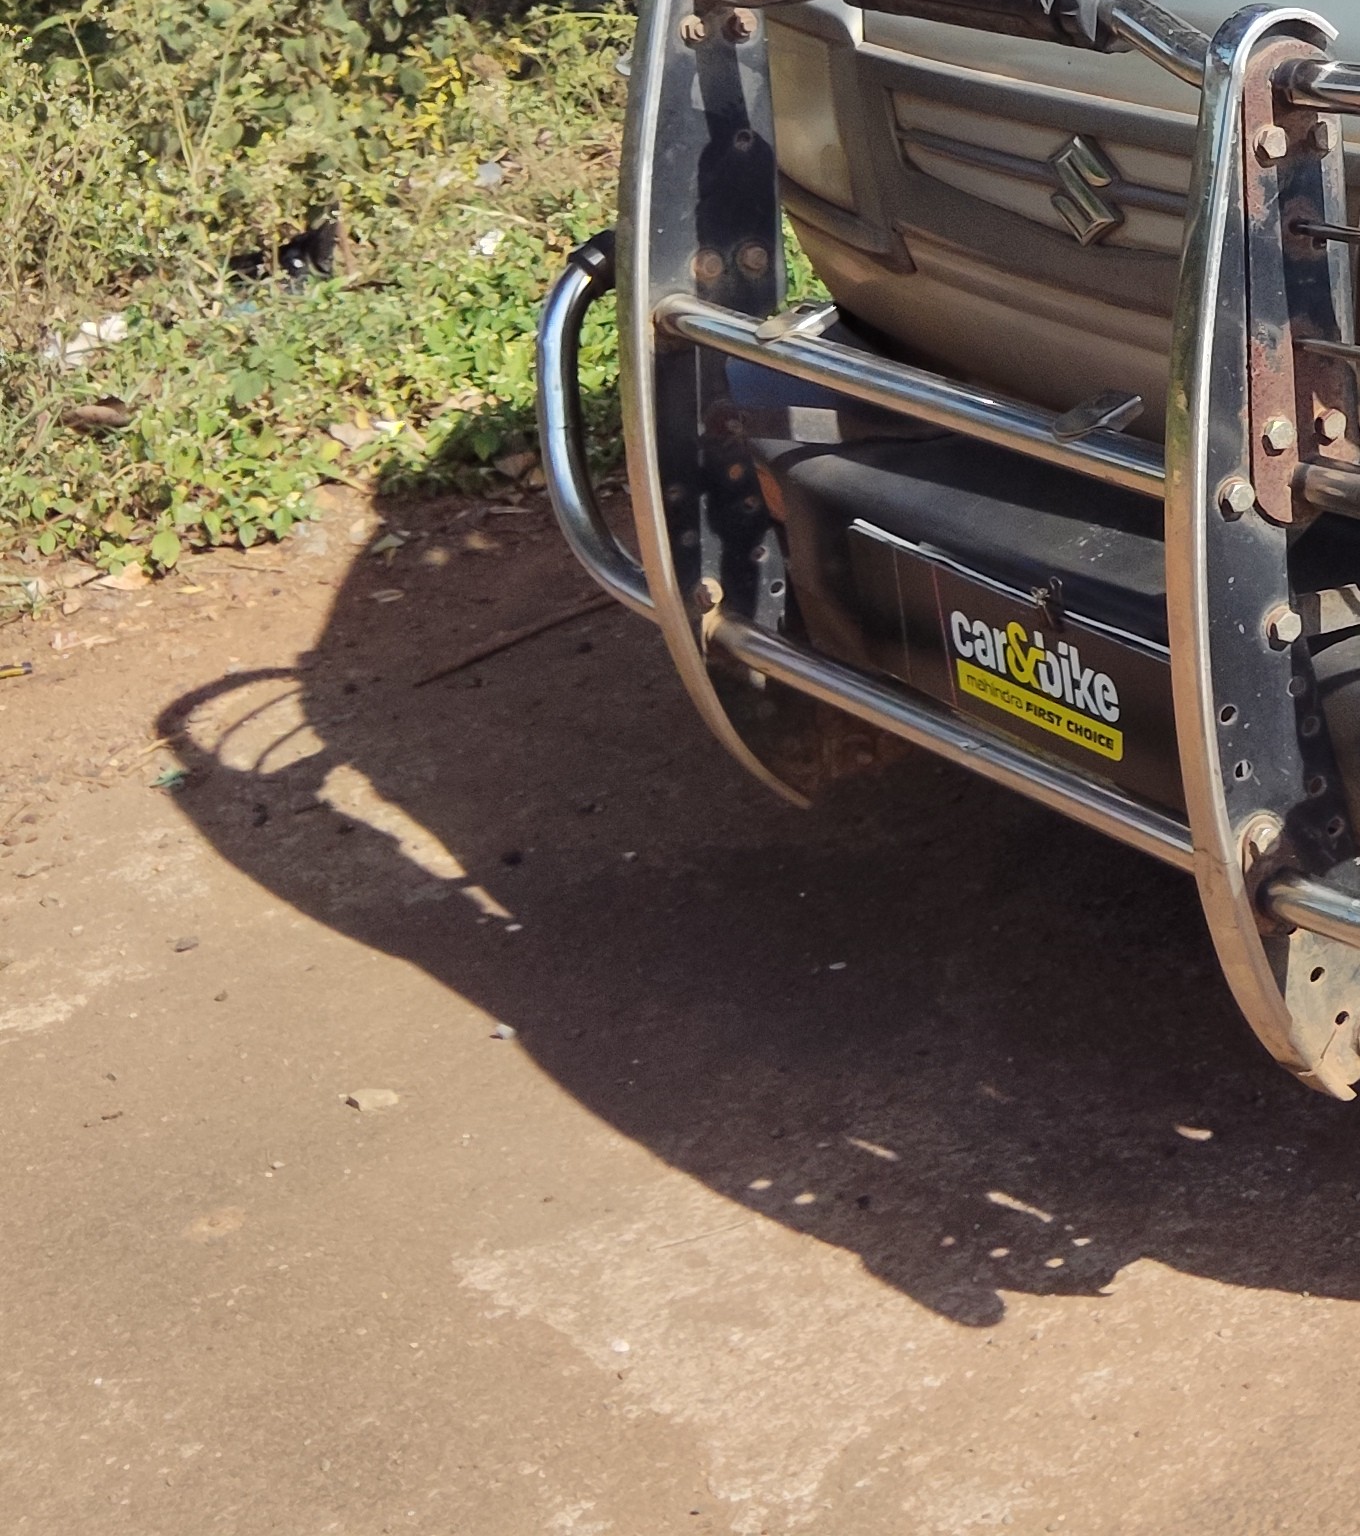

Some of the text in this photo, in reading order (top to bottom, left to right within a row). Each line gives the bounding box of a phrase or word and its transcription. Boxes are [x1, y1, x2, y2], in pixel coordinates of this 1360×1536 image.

[950, 610, 1120, 723] car&bike
[966, 673, 1115, 751] mahindra FIRST CHOICE
